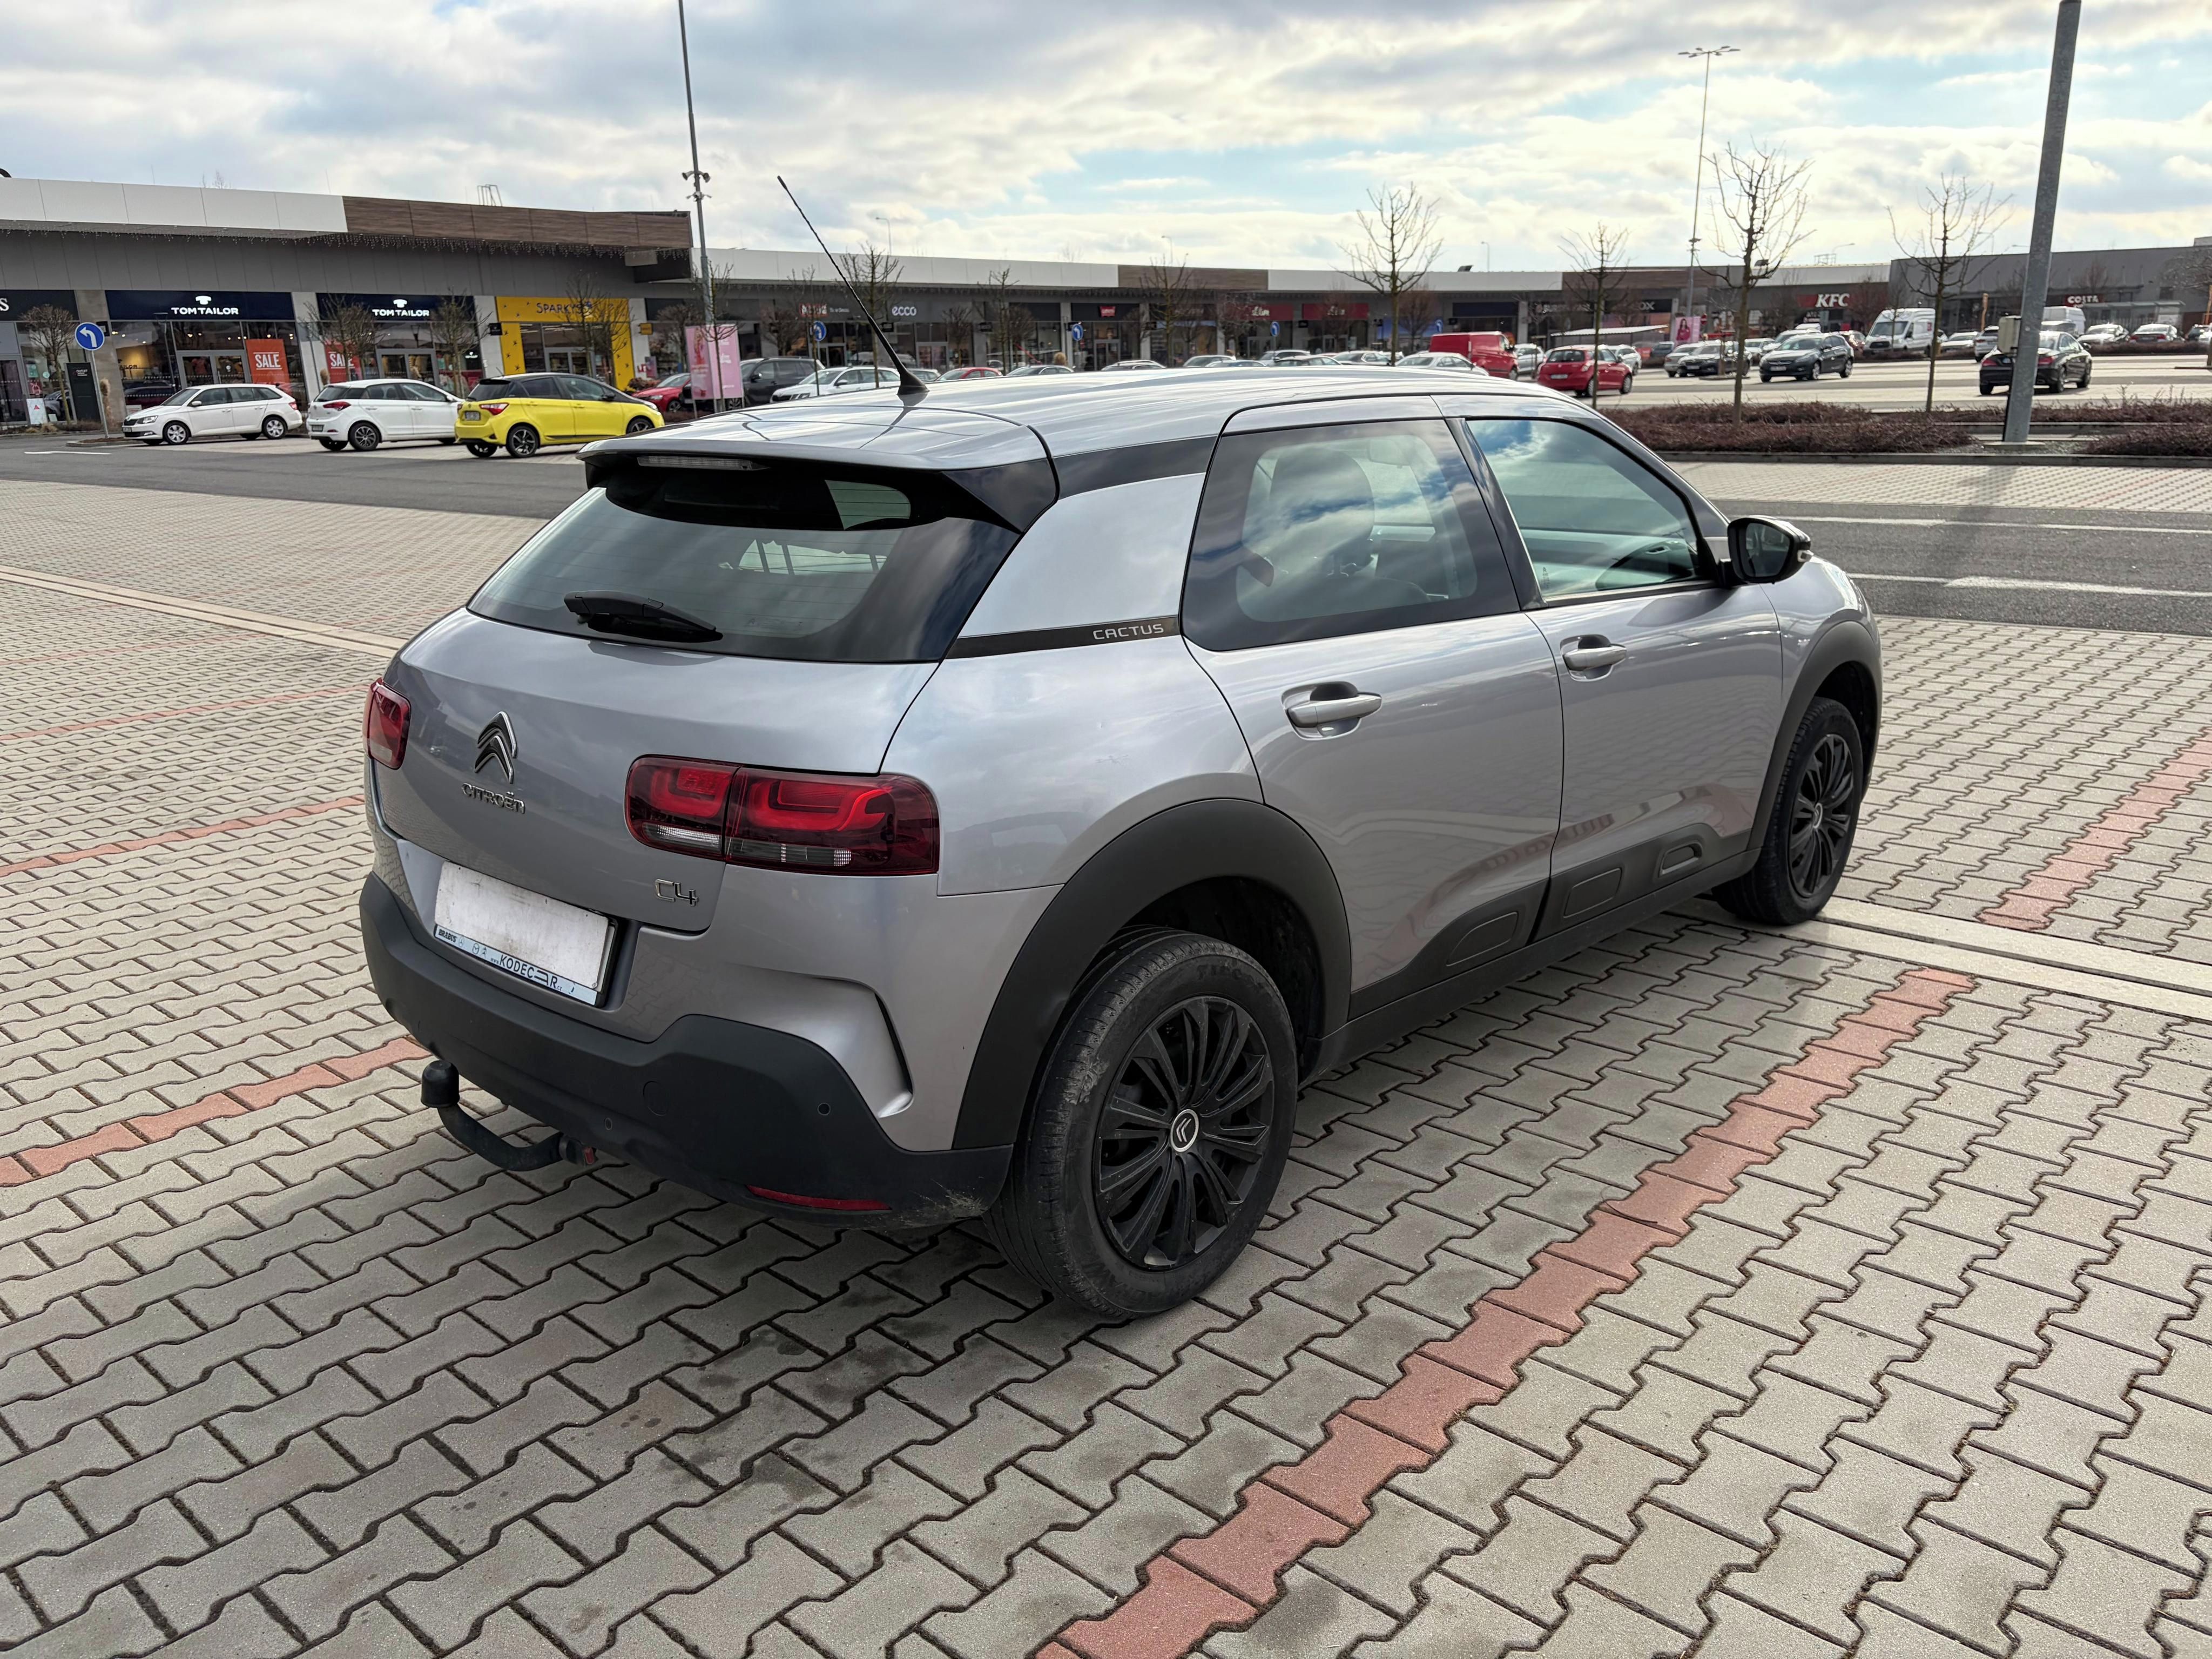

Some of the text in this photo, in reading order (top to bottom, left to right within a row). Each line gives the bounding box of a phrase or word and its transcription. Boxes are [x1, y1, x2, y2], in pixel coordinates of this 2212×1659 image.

[1815, 293, 1850, 307] KFC
[171, 307, 239, 315] TOM TAILOR
[395, 309, 430, 317] TAILOR
[892, 306, 917, 316] ecco
[254, 354, 281, 368] SALE
[1092, 624, 1164, 640] CACTUS
[654, 879, 699, 907] C4
[438, 929, 457, 943] BRABUS
